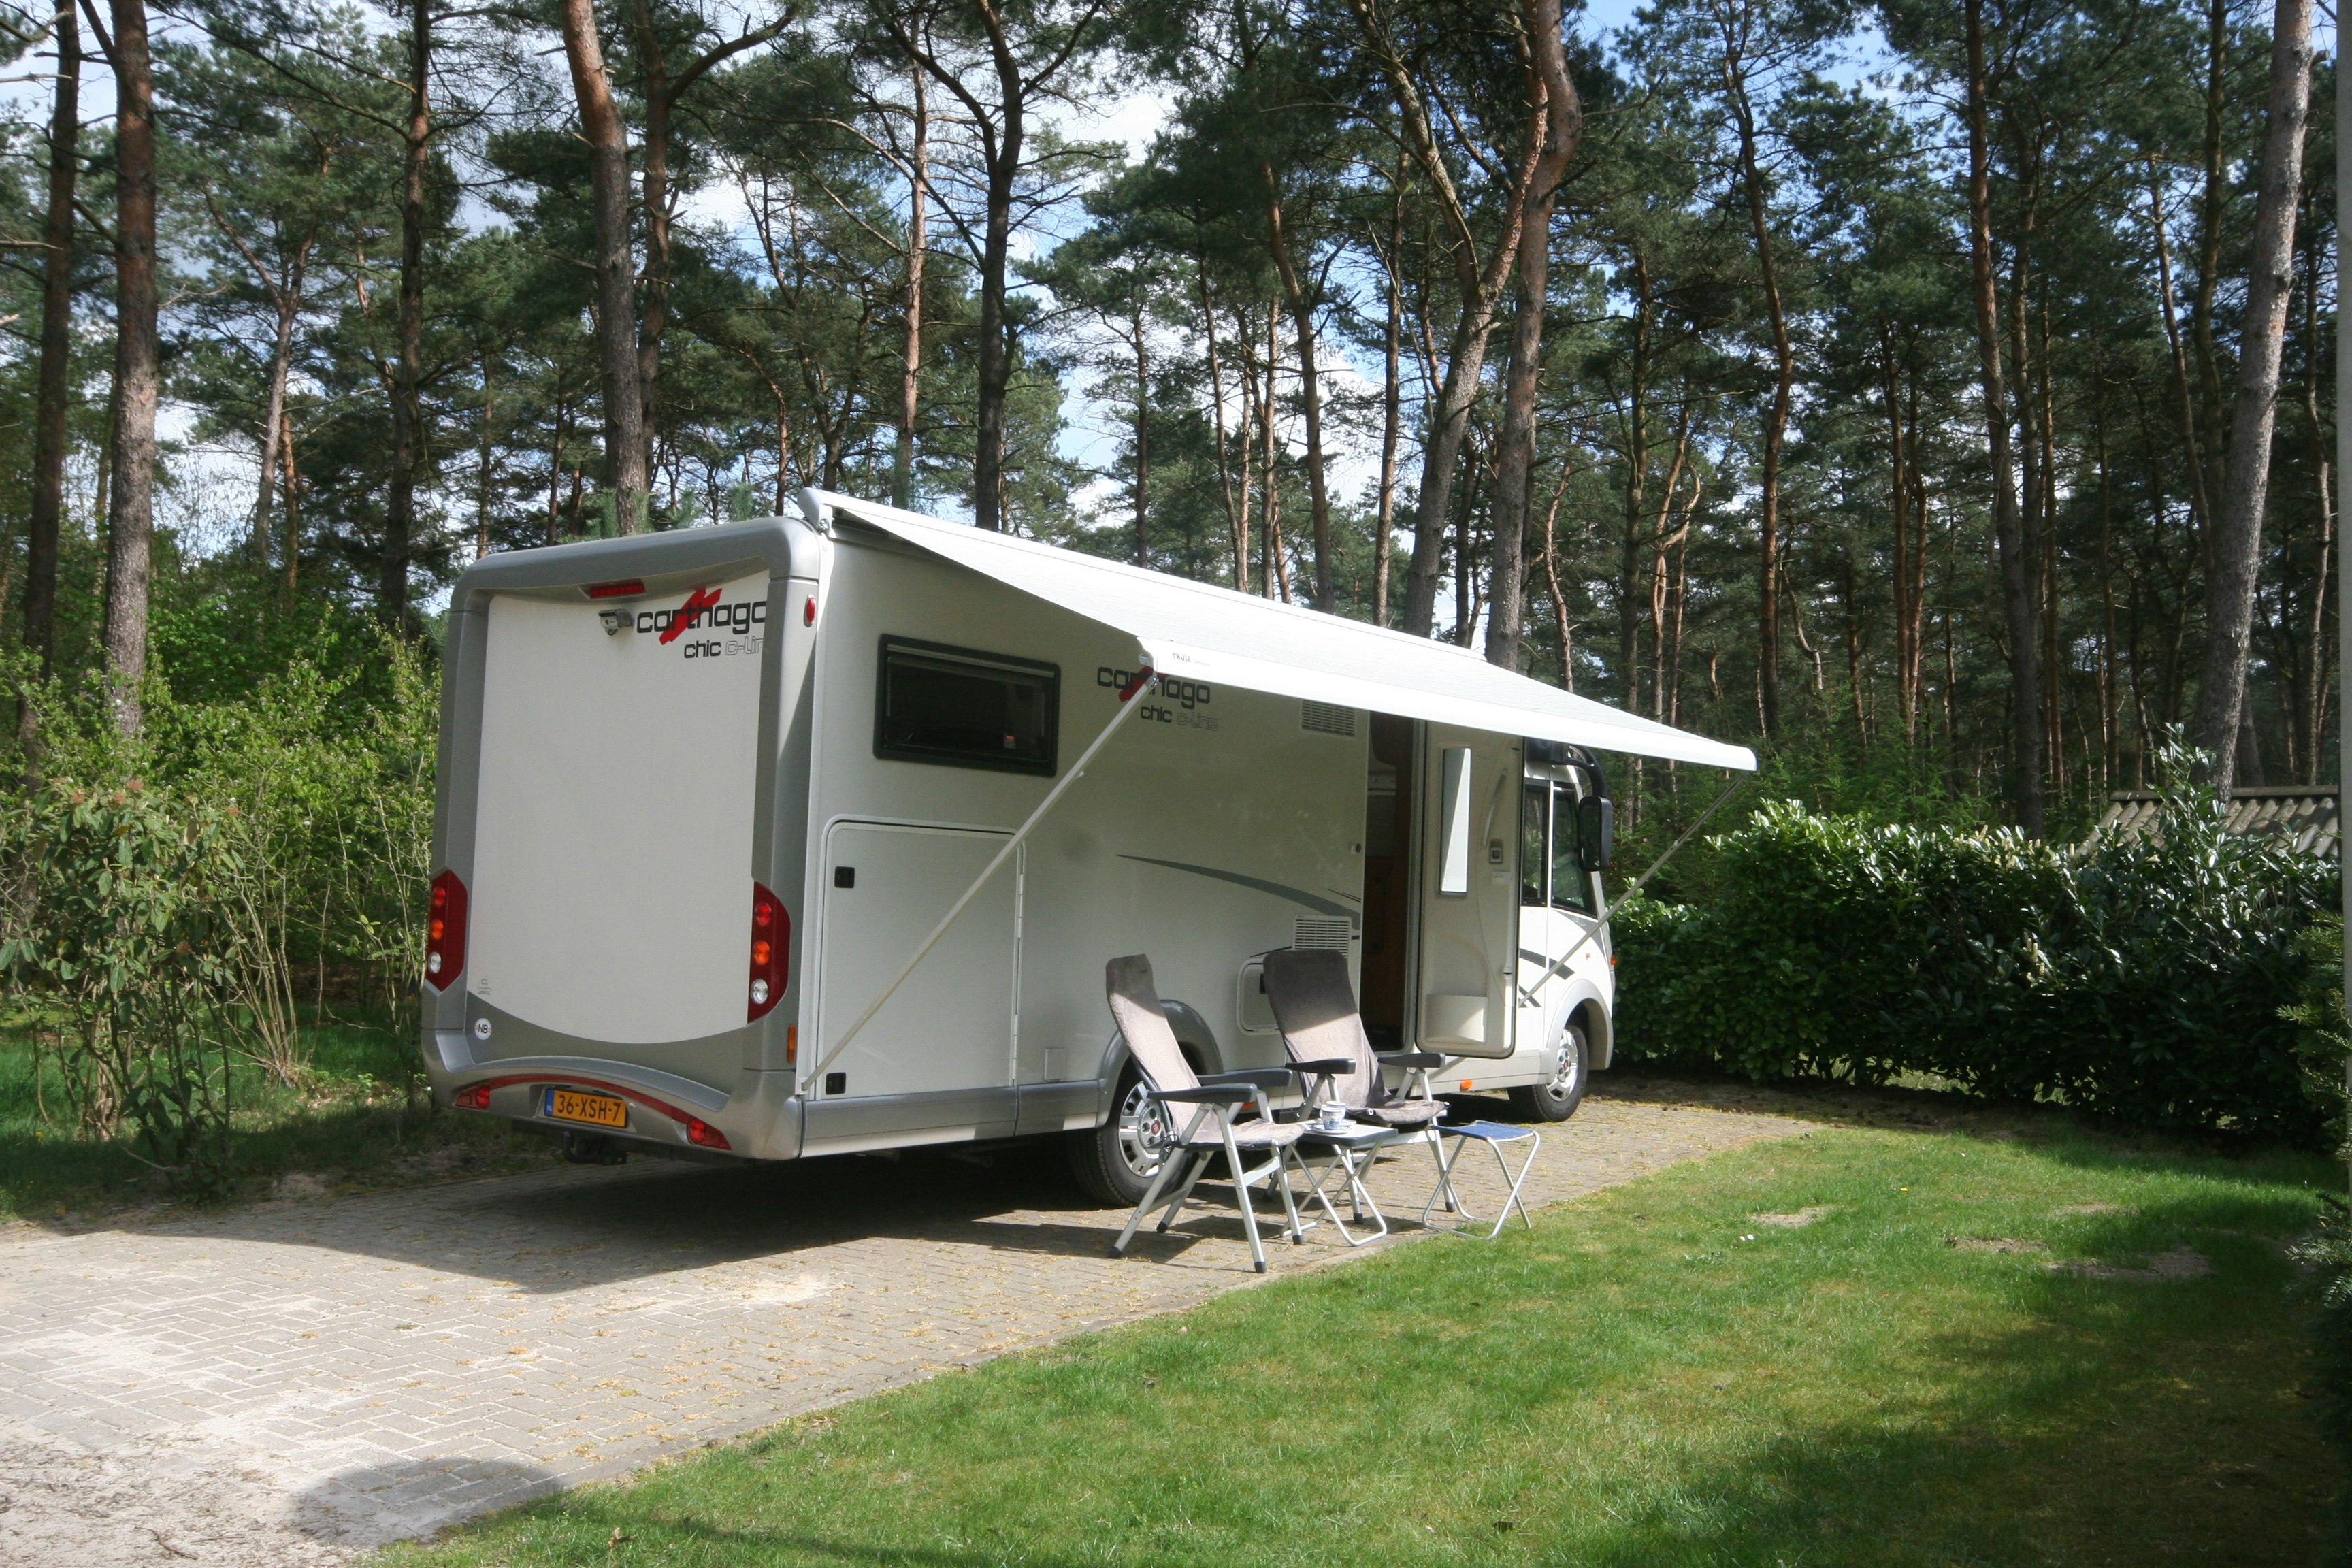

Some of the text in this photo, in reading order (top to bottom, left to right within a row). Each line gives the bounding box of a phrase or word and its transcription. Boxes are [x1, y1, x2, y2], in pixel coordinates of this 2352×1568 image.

[684, 636, 764, 658] chic c-lin
[1141, 705, 1172, 723] chic
[557, 1094, 621, 1122] 36-XSH-7
